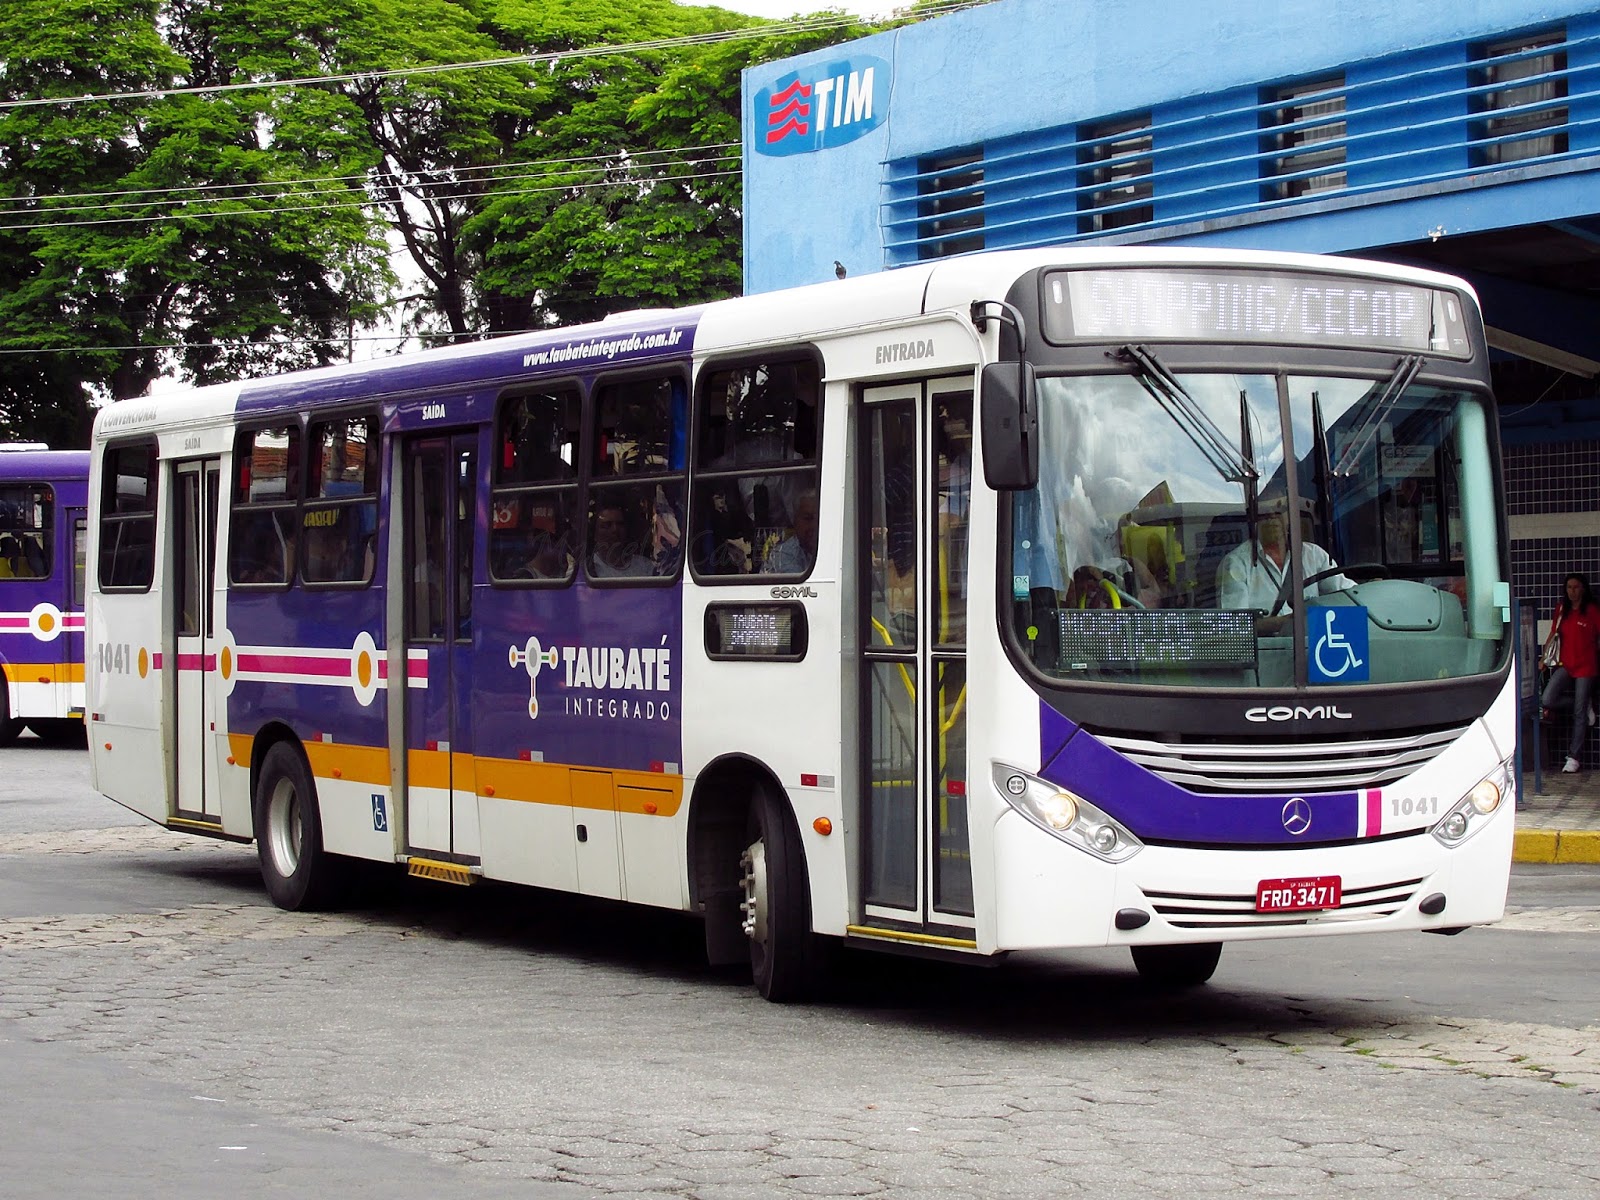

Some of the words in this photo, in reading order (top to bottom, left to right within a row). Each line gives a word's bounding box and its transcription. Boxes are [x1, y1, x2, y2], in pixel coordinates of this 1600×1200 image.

[814, 67, 875, 131] TIM
[1091, 276, 1415, 336] SHOPPING/CECAP
[523, 327, 683, 368] www.taubateintegrado.com.br
[875, 338, 934, 364] ENTRADA
[103, 407, 157, 428] CONVENCIONAL
[422, 402, 446, 420] SAÍDA
[770, 587, 818, 599] COMIL
[98, 643, 131, 674] 1041
[562, 634, 671, 691] TAUBATÉ
[565, 694, 671, 721] INTEGRADO
[1245, 705, 1353, 722] COMIL
[1391, 796, 1438, 817] 1041
